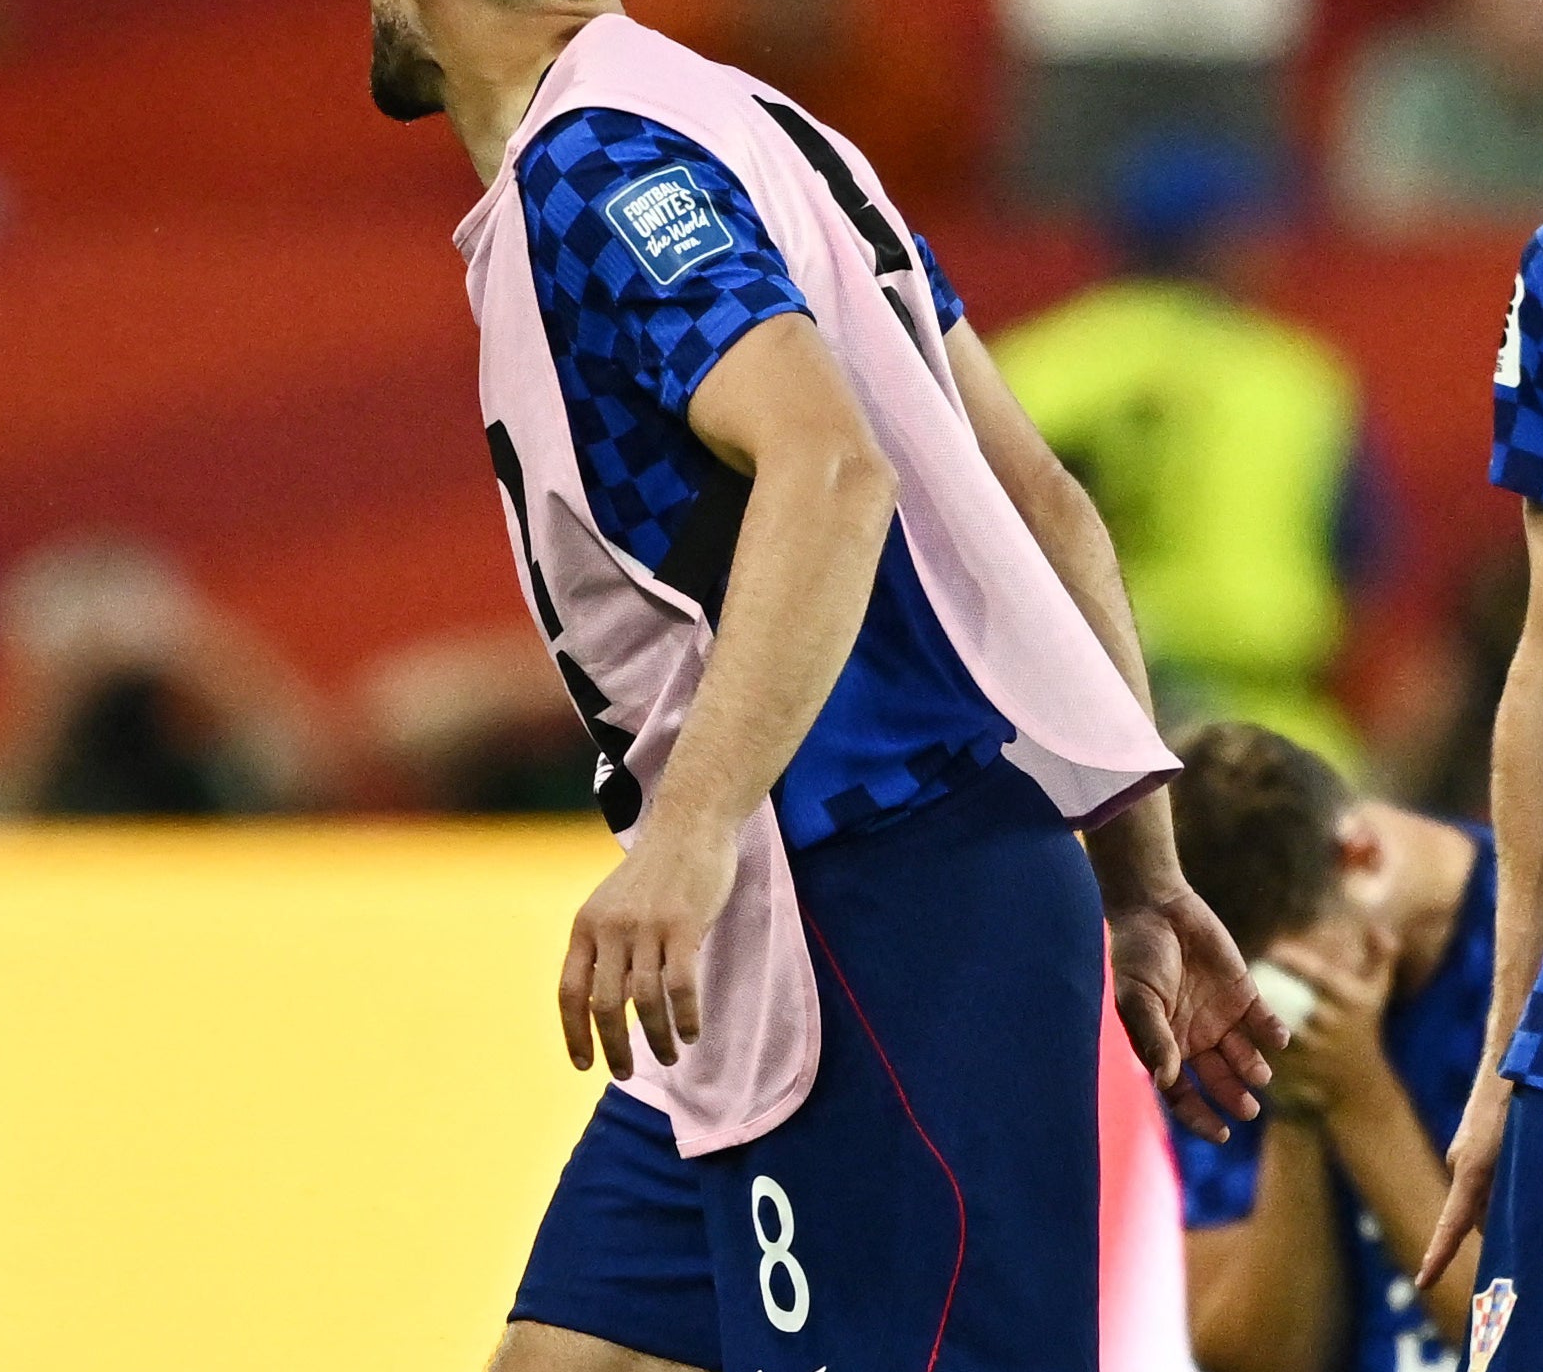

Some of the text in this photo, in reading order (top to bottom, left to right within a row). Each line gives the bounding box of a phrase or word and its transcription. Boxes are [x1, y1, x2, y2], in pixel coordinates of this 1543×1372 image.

[623, 181, 681, 222] FOOTBALL
[632, 189, 697, 238] UNITES
[645, 207, 712, 258] the World
[751, 1175, 810, 1334] 8
